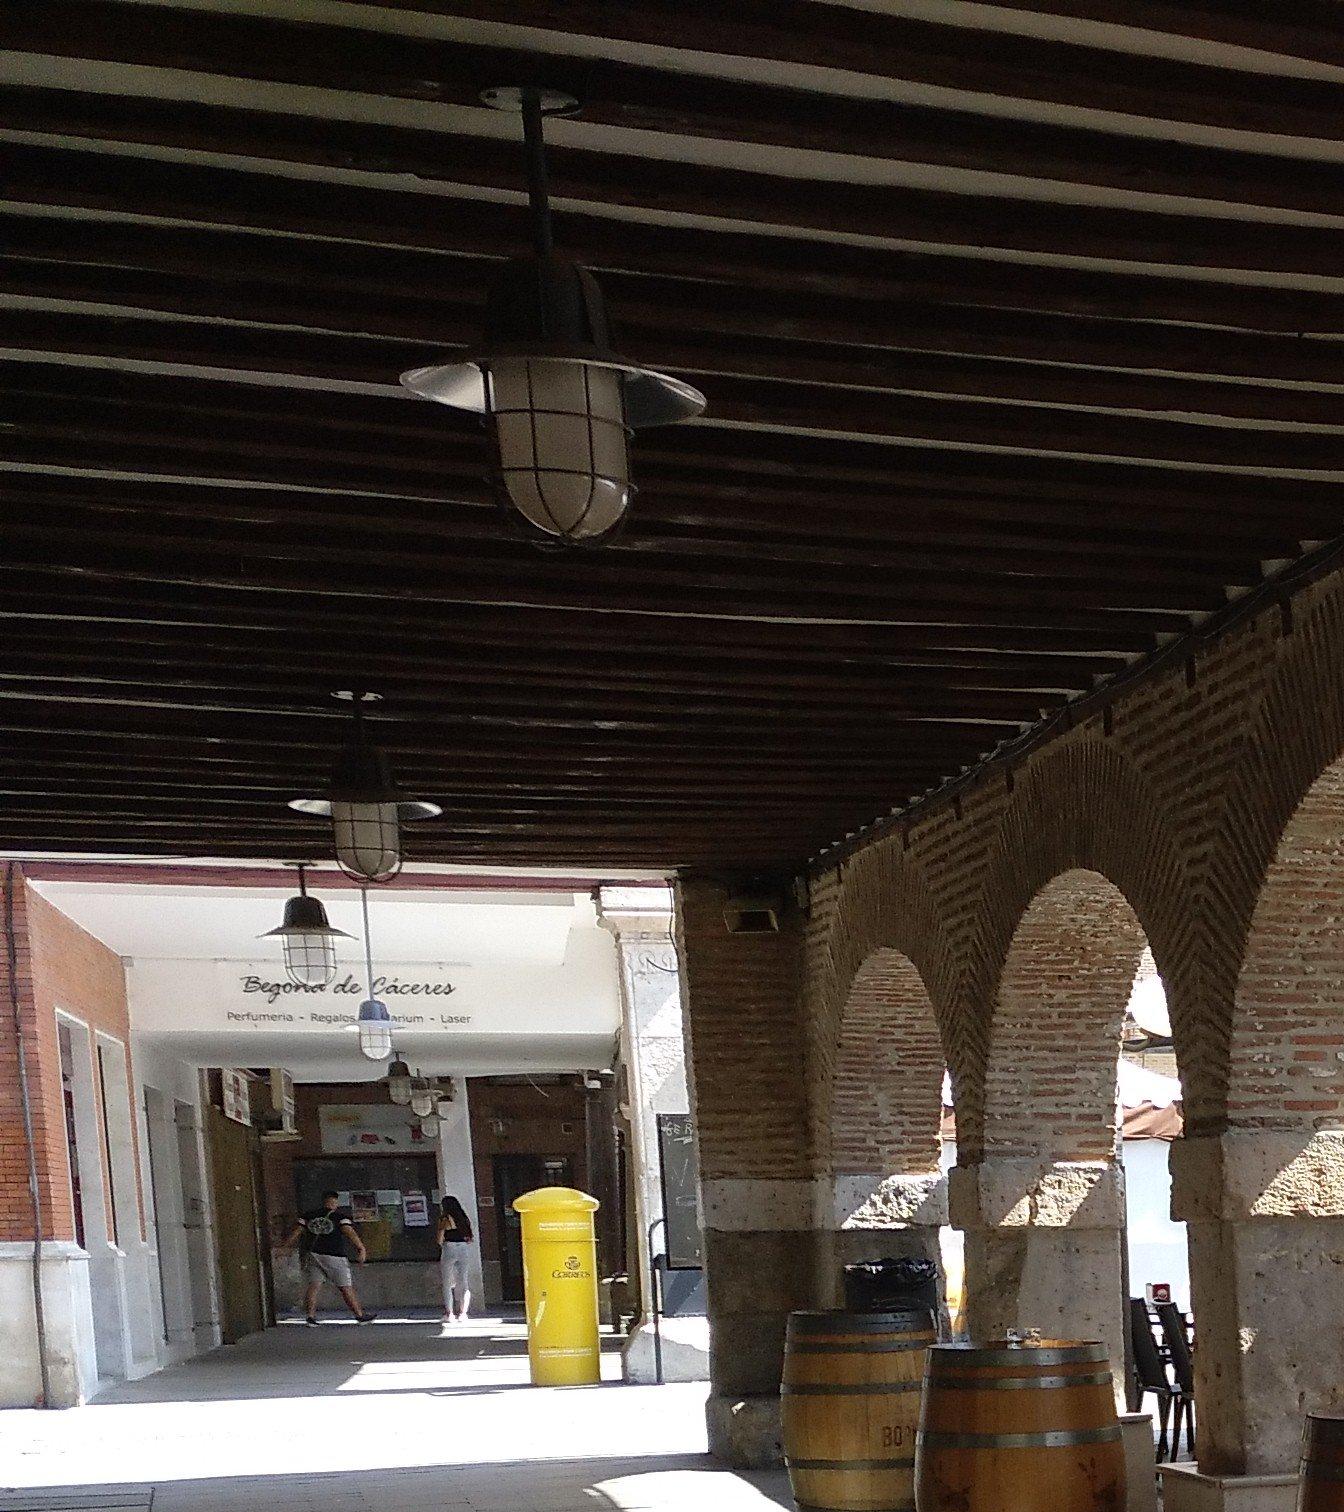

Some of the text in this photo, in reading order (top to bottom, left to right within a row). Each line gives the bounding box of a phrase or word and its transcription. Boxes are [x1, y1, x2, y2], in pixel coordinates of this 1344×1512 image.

[333, 975, 362, 995] de
[371, 976, 456, 996] Cáceres
[310, 1012, 356, 1025] Regalos
[440, 1014, 472, 1024] Laser
